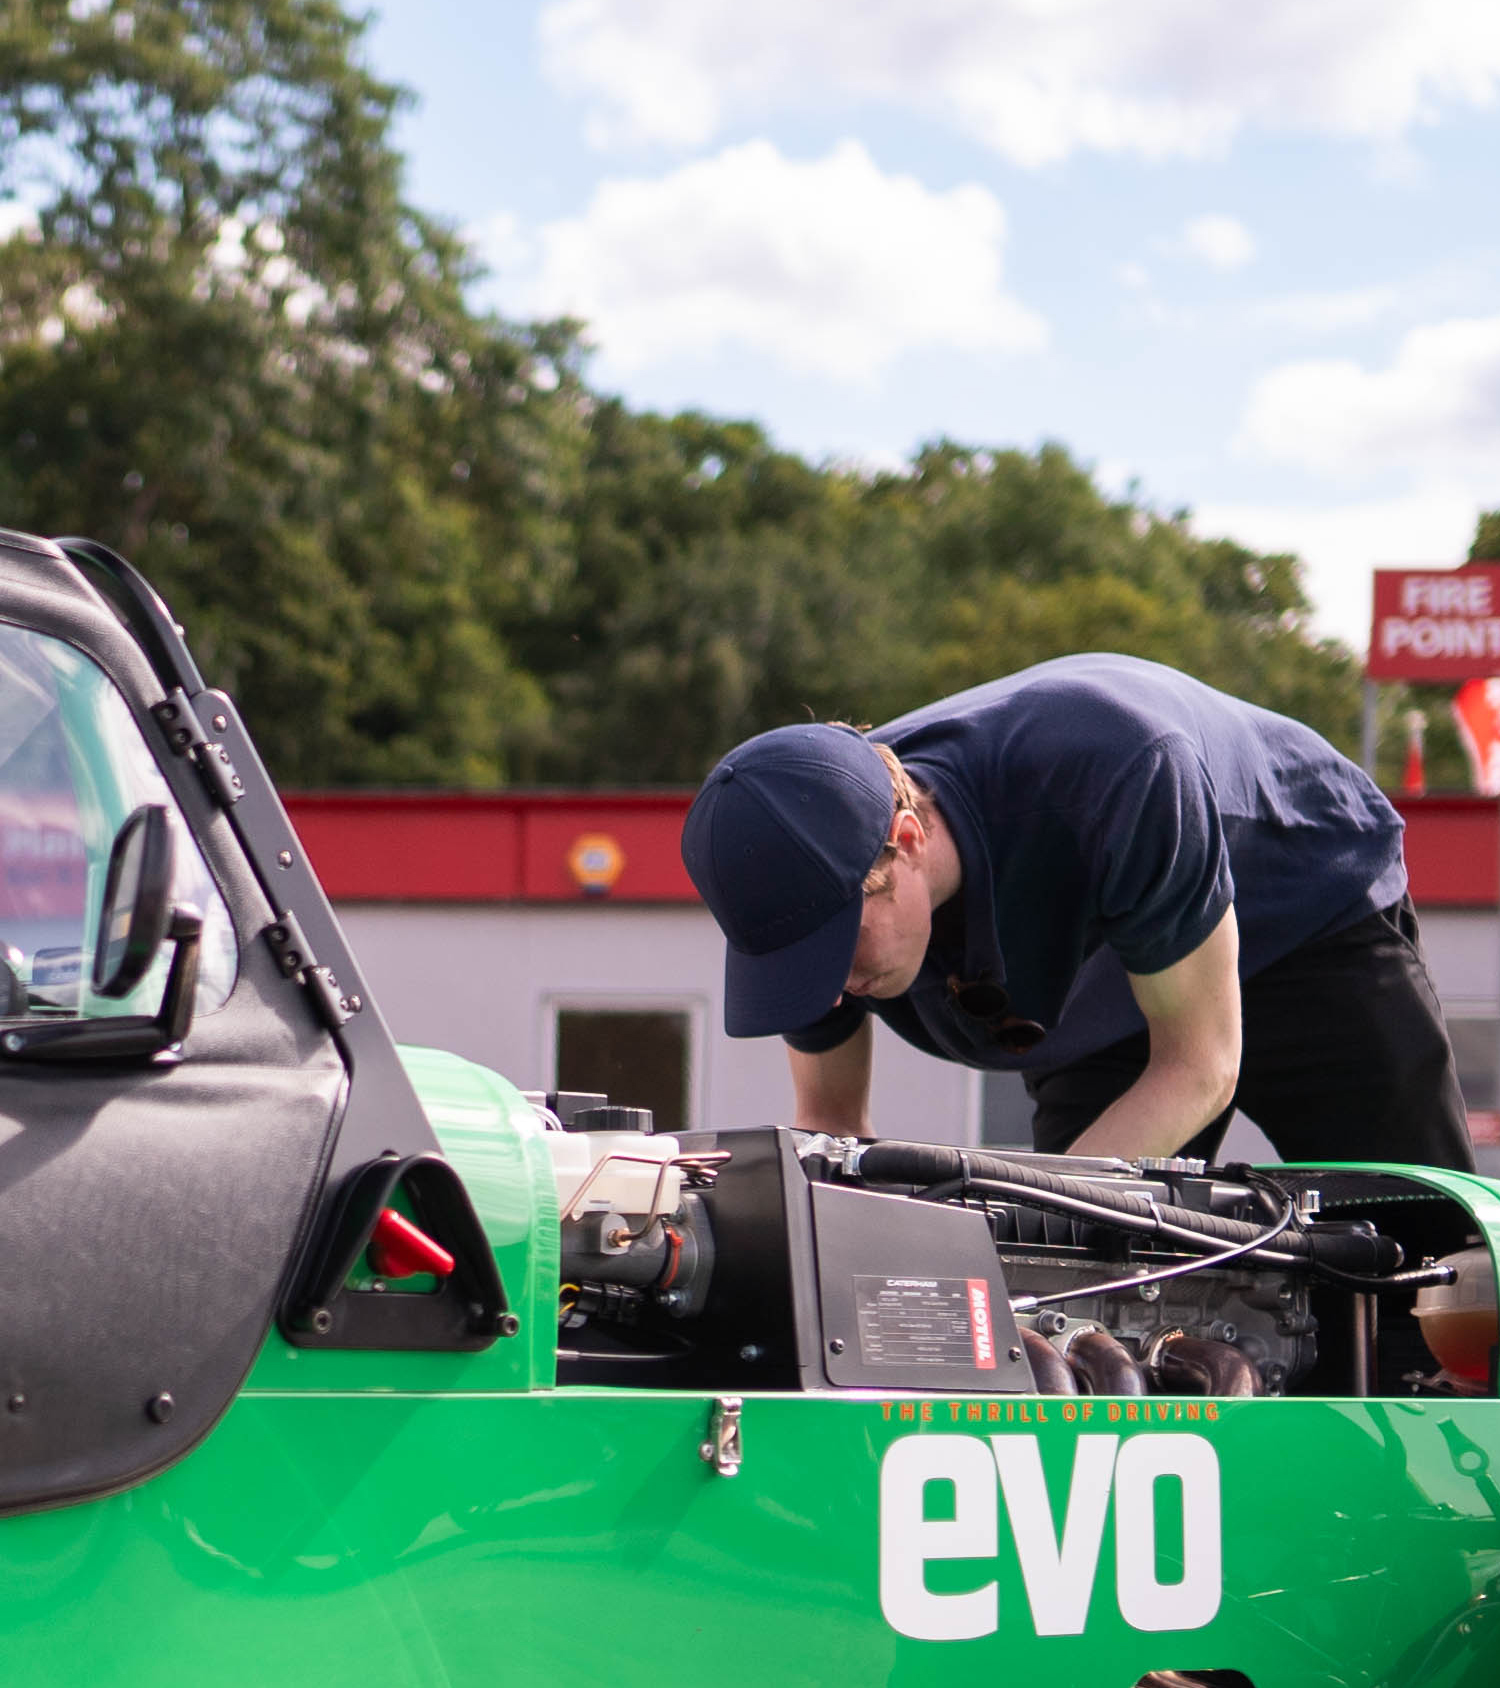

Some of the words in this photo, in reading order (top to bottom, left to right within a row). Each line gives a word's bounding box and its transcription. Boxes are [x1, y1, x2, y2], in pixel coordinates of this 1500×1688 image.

[1402, 575, 1492, 616] FIRE
[971, 1287, 992, 1361] MOTUL
[881, 1402, 934, 1421] THE
[951, 1402, 1049, 1422] THRILL
[1063, 1403, 1093, 1421] OF
[1108, 1402, 1220, 1421] DRIVING
[879, 1432, 1222, 1641] evo
